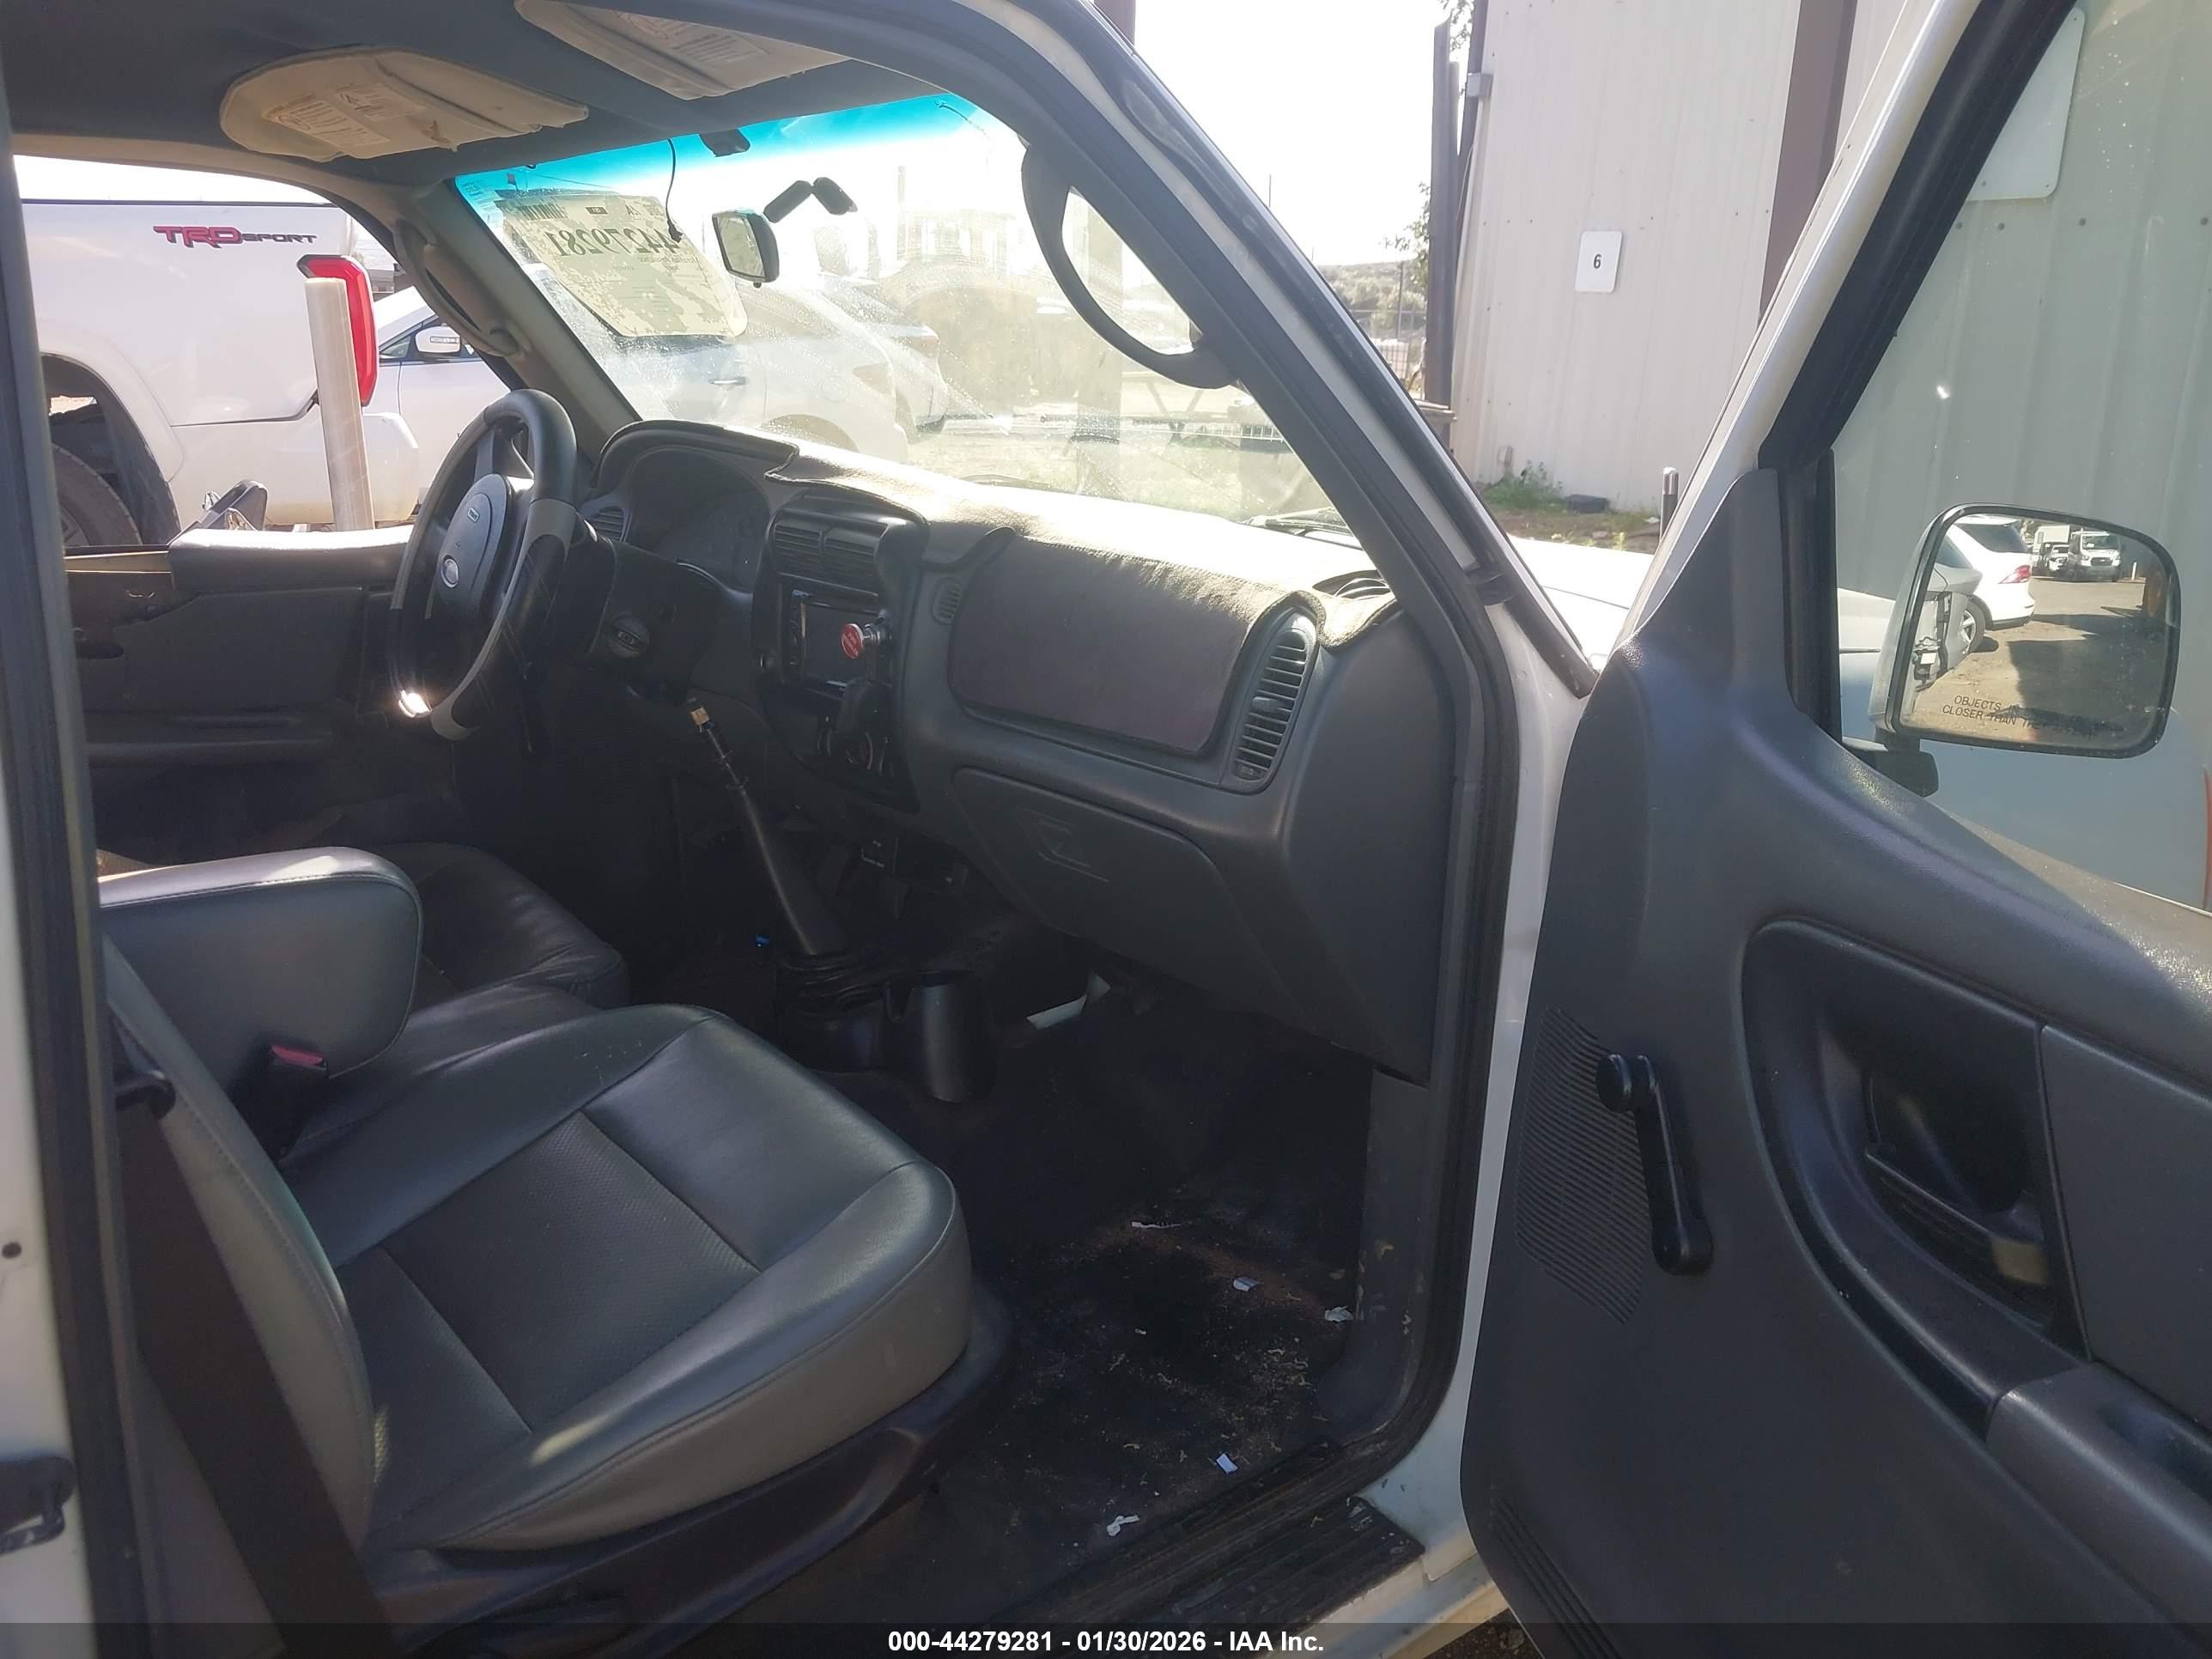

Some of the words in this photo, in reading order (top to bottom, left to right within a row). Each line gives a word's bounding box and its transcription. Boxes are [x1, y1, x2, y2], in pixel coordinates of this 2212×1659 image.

[152, 226, 243, 249] TRD
[241, 233, 318, 244] SPORT
[1593, 253, 1602, 270] 6
[1954, 695, 2002, 711] OBJECTS
[1942, 704, 1984, 720] CLOSER
[1989, 714, 2017, 727] THAN
